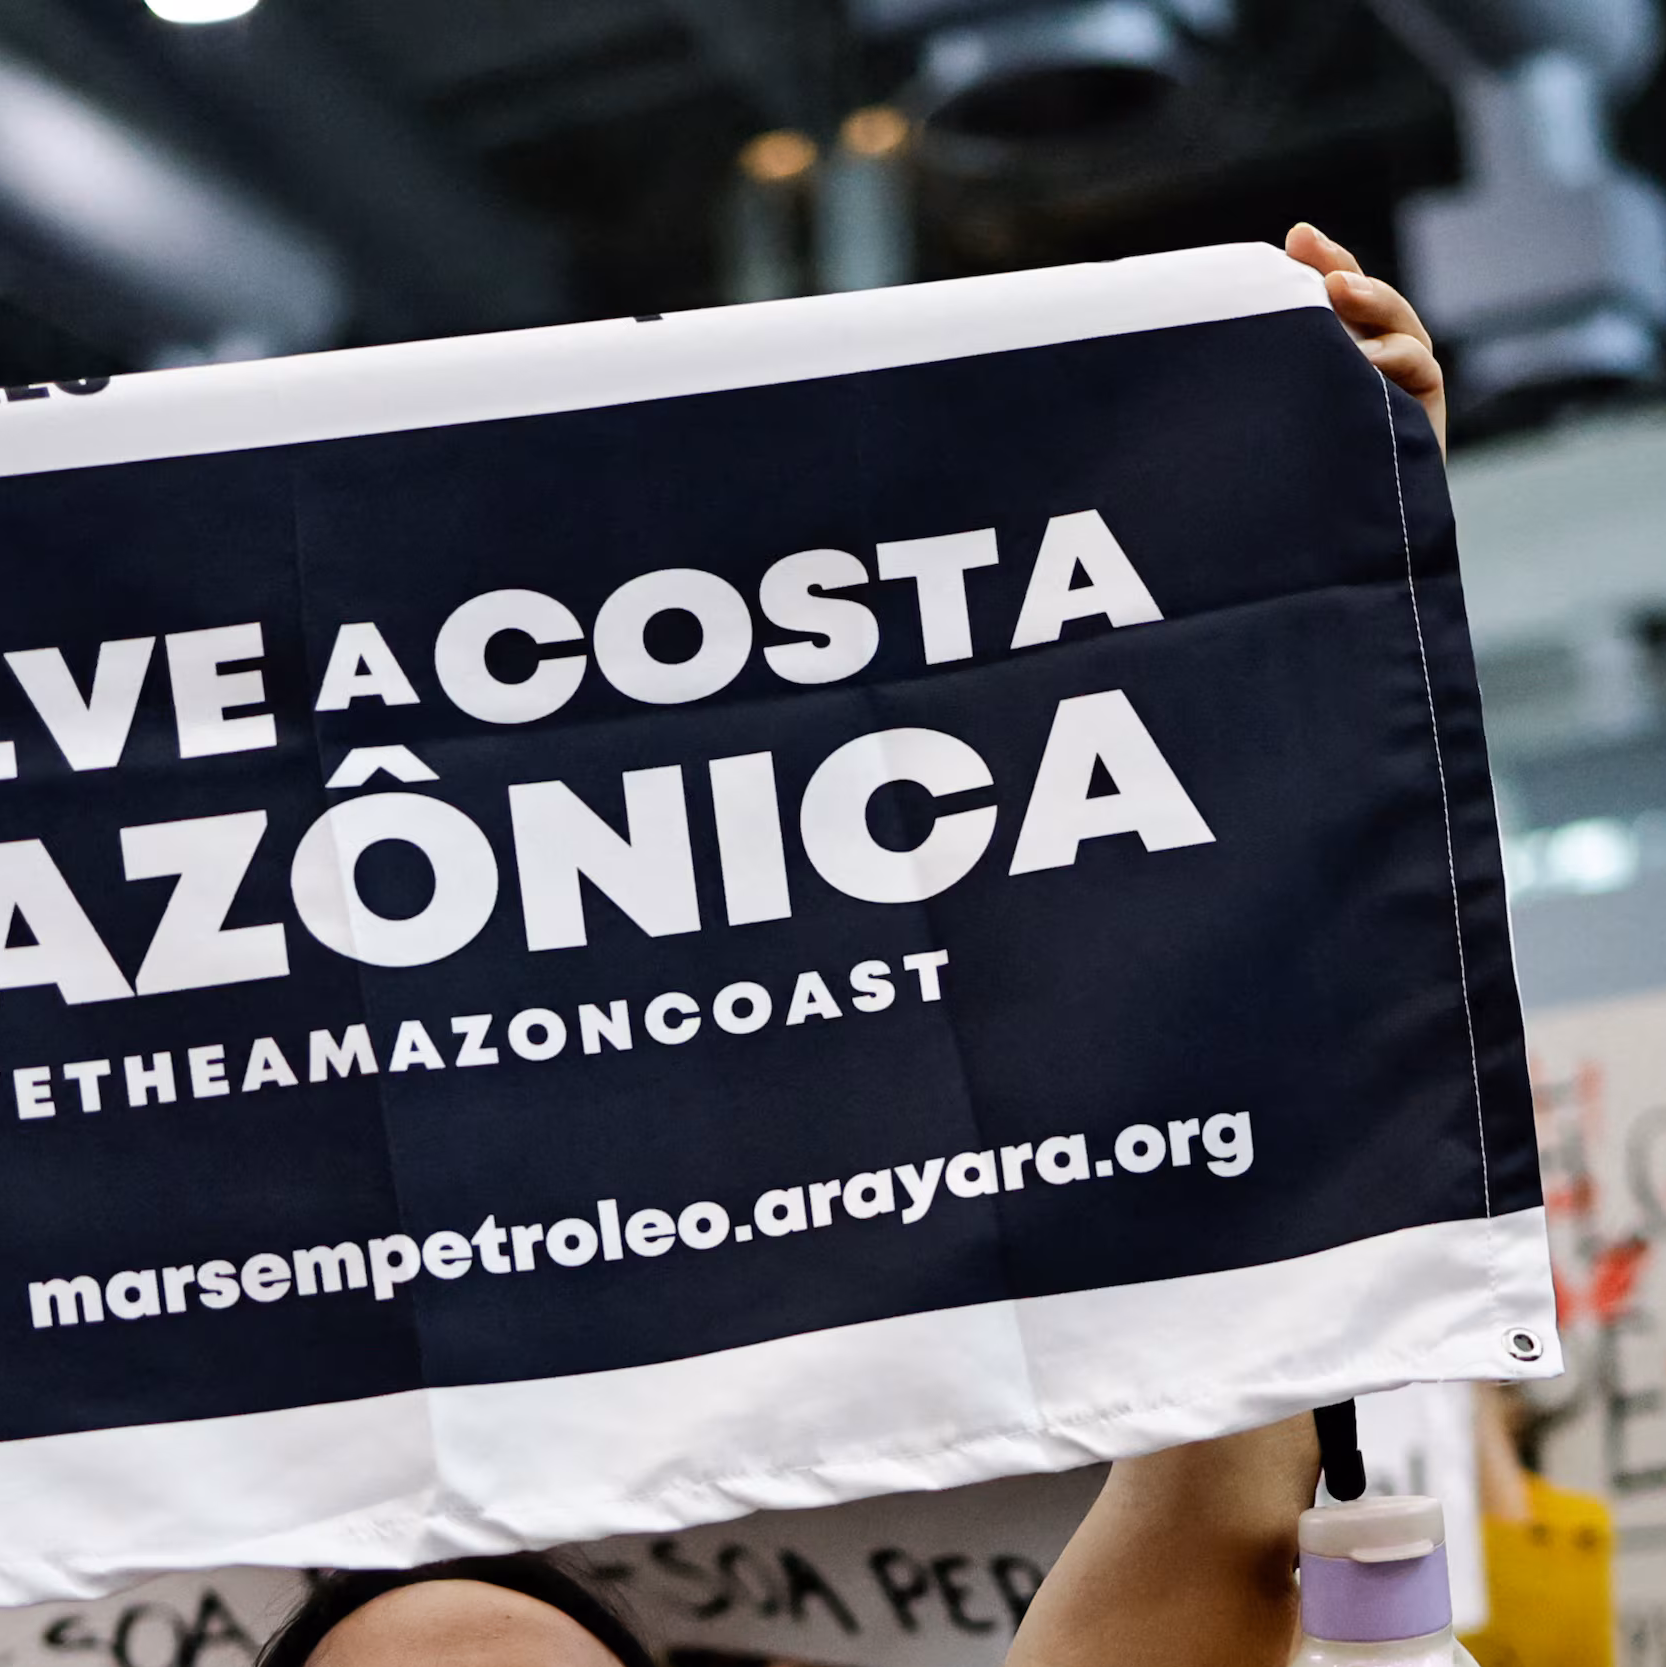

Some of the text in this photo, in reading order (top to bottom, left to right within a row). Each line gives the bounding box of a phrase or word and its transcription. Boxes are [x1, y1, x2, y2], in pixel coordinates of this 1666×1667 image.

[314, 621, 421, 712] A
[434, 508, 1165, 724] COSTA
[28, 1110, 1254, 1329] marsempetroleo.arayara.org
